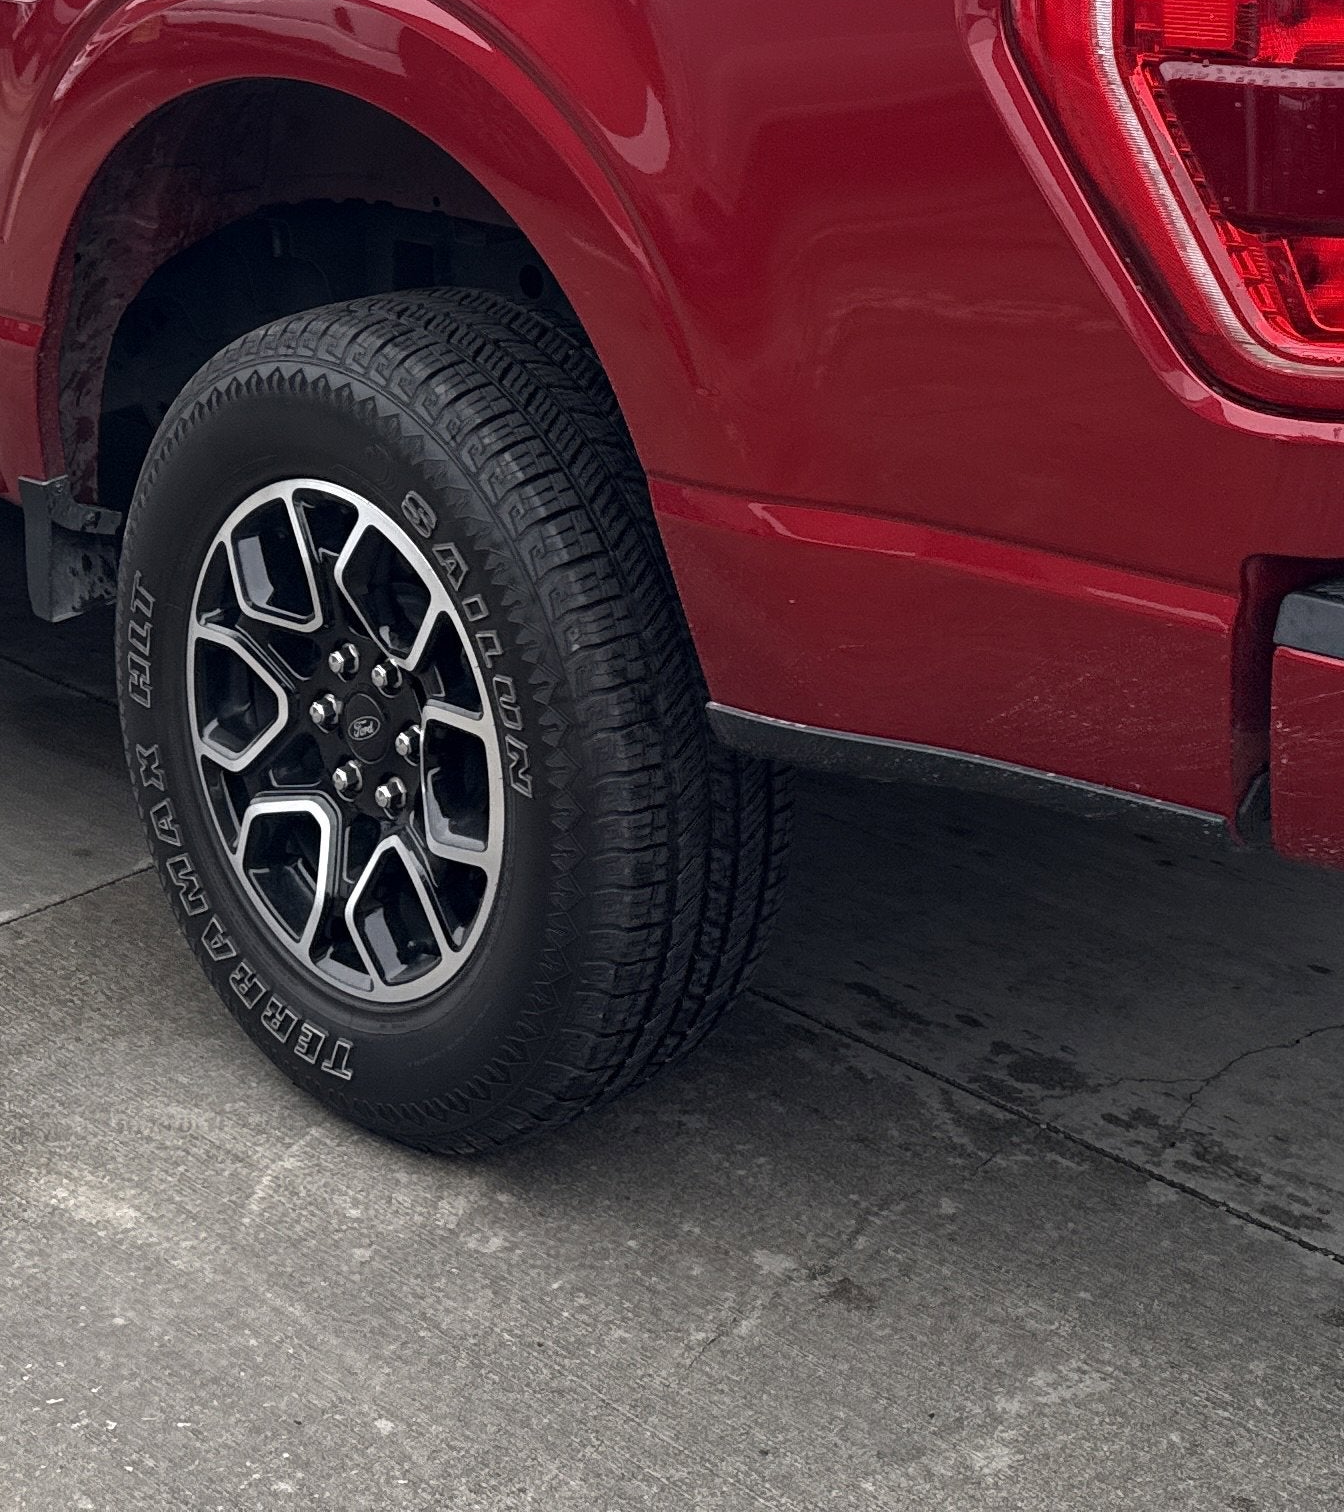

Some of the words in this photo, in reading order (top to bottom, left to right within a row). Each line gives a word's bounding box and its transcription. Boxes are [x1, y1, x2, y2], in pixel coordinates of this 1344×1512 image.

[127, 569, 156, 709] HLT
[353, 719, 375, 738] Ford
[401, 489, 534, 799] SAILUN
[136, 743, 355, 1081] TERRAMAX
